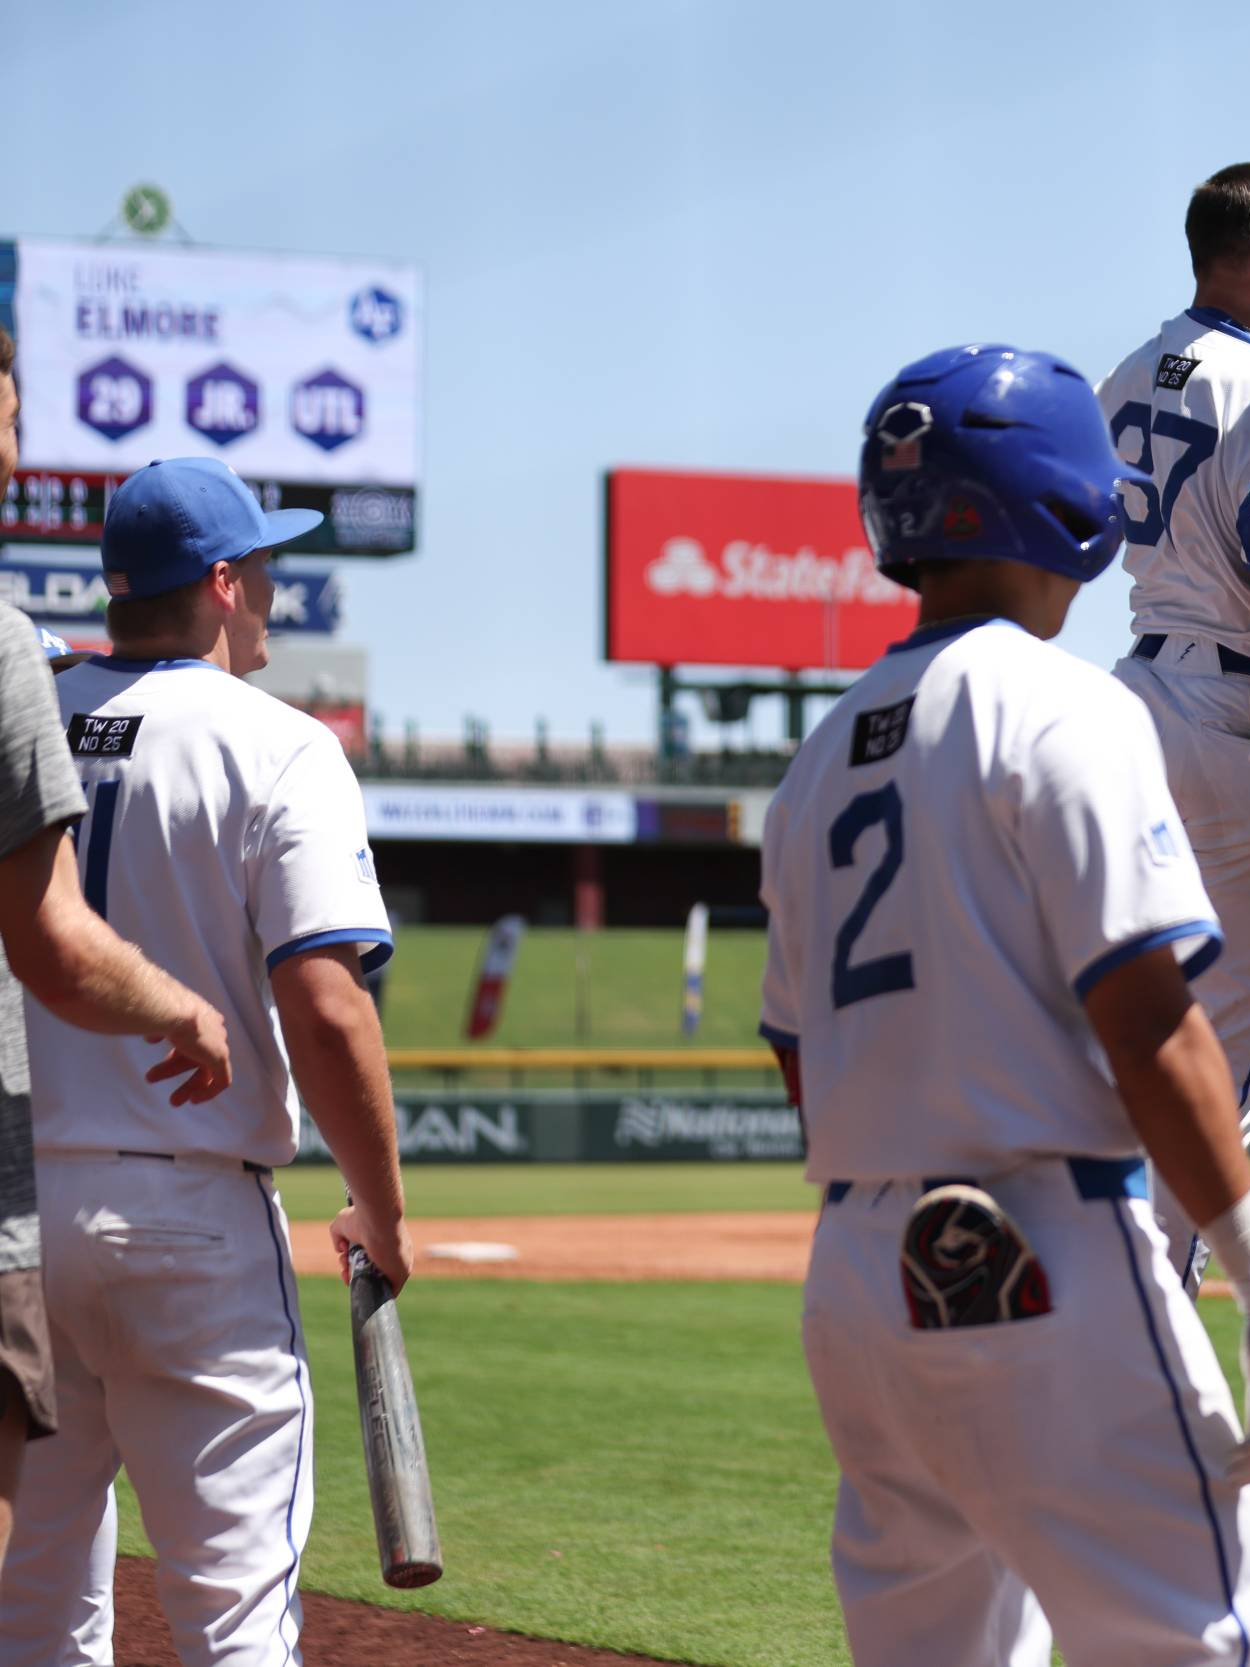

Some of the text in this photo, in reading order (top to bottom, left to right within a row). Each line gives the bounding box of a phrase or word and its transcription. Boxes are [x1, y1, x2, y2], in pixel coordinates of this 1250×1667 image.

[77, 302, 220, 341] ELMORE
[1168, 373, 1182, 385] 25
[1176, 360, 1191, 371] 20
[88, 375, 143, 426] 29
[295, 386, 362, 436] UTL
[1110, 400, 1219, 554] 37
[85, 718, 130, 733] TW 20
[102, 736, 123, 751] 25
[828, 777, 916, 1012] 2
